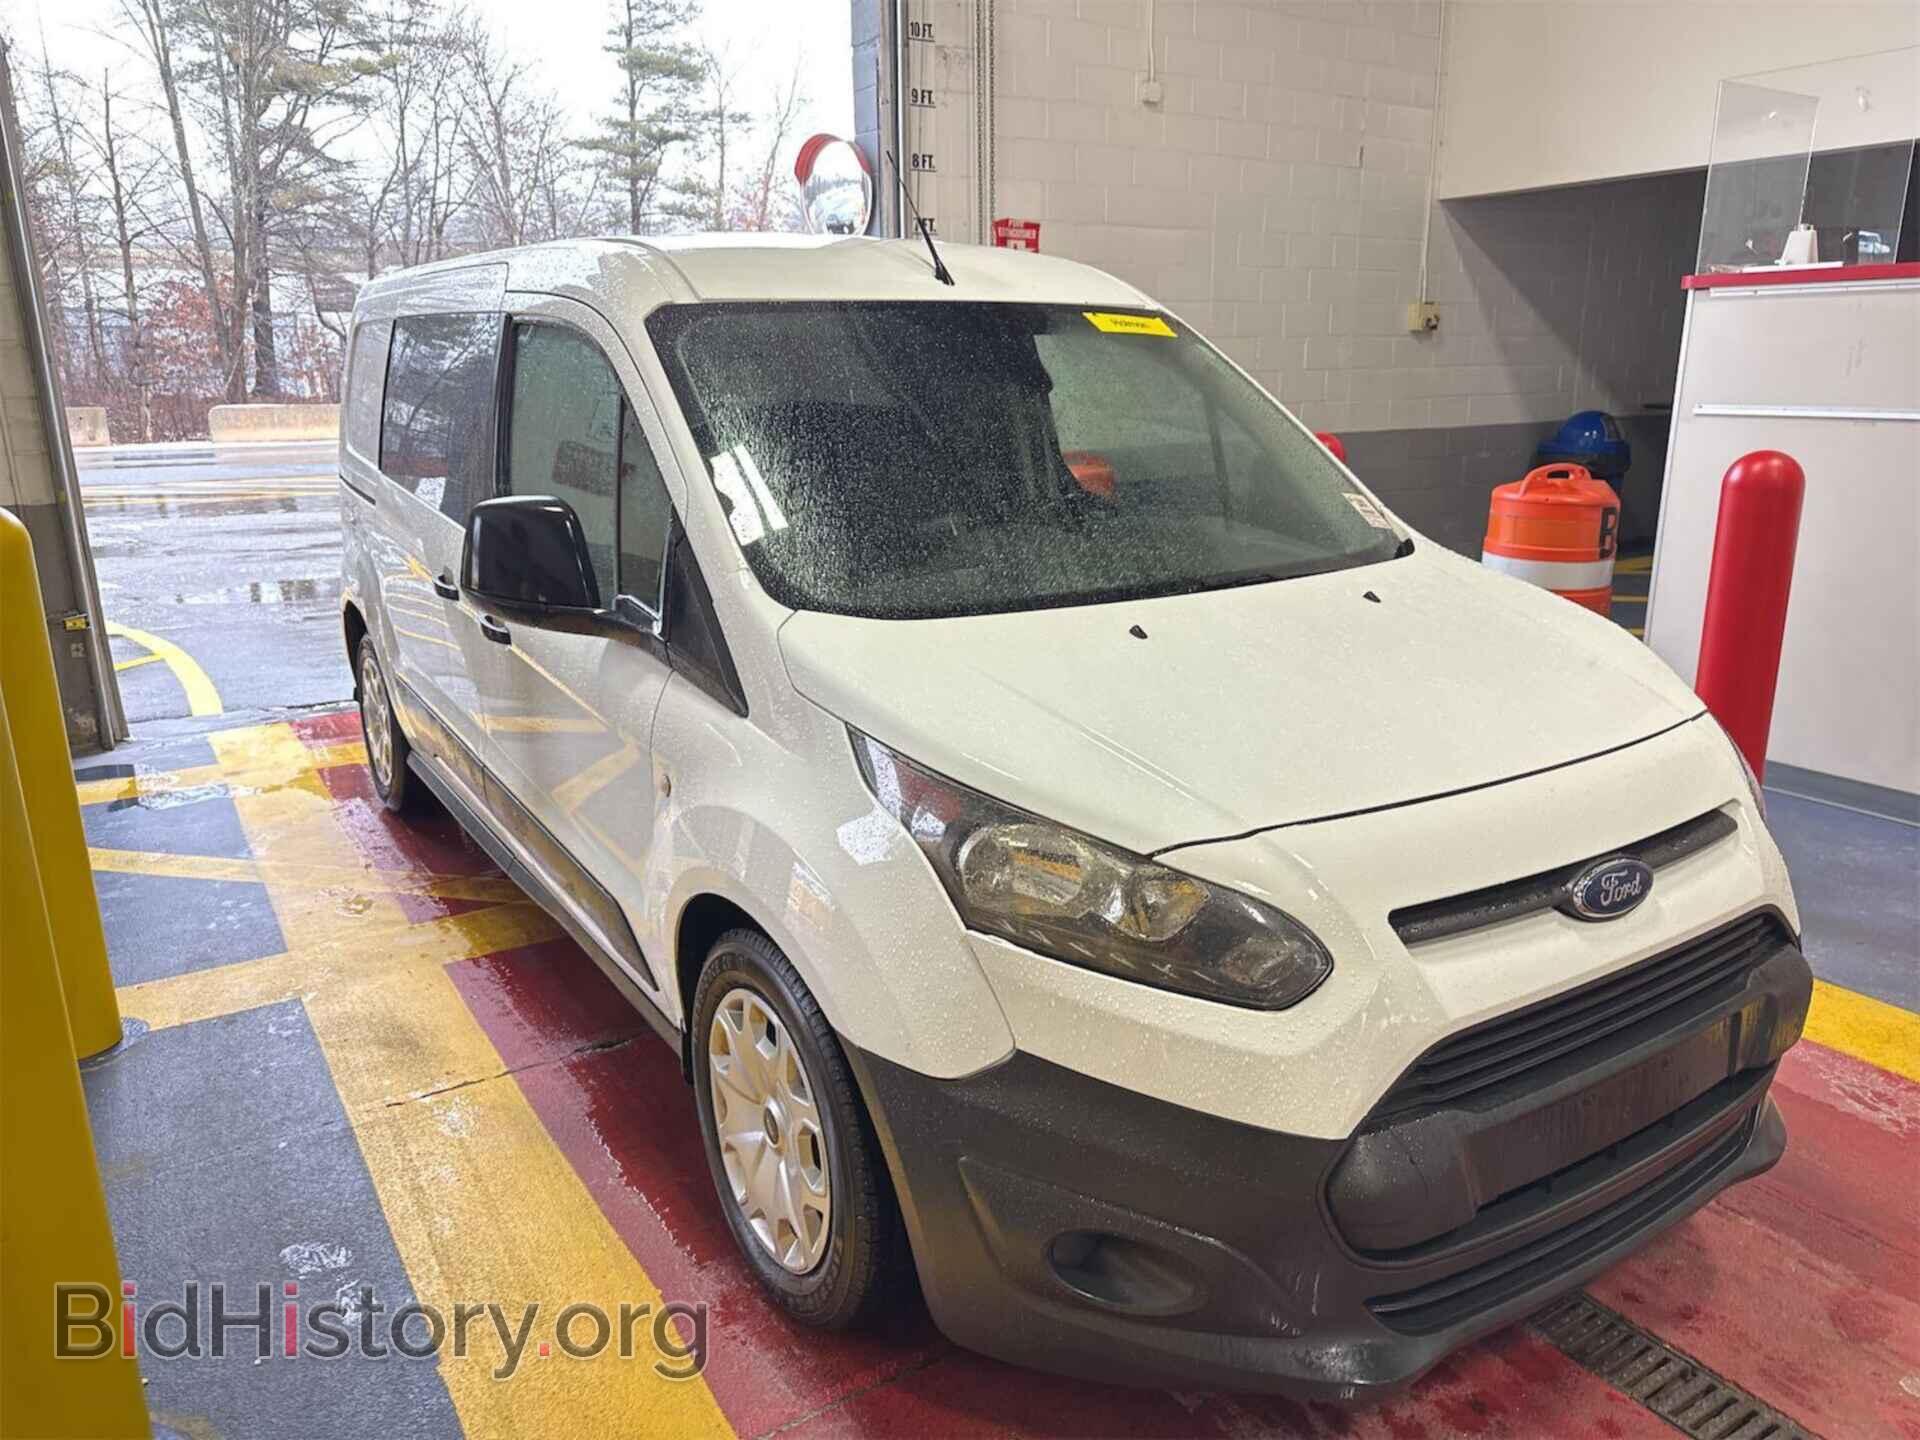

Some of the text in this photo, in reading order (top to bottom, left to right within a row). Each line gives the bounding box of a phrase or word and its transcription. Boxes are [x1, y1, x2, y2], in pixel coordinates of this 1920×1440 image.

[910, 21, 935, 38] 10 FT.
[911, 88, 935, 105] 9 FT.
[912, 153, 936, 170] 8 FT.
[1600, 868, 1641, 907] Ford
